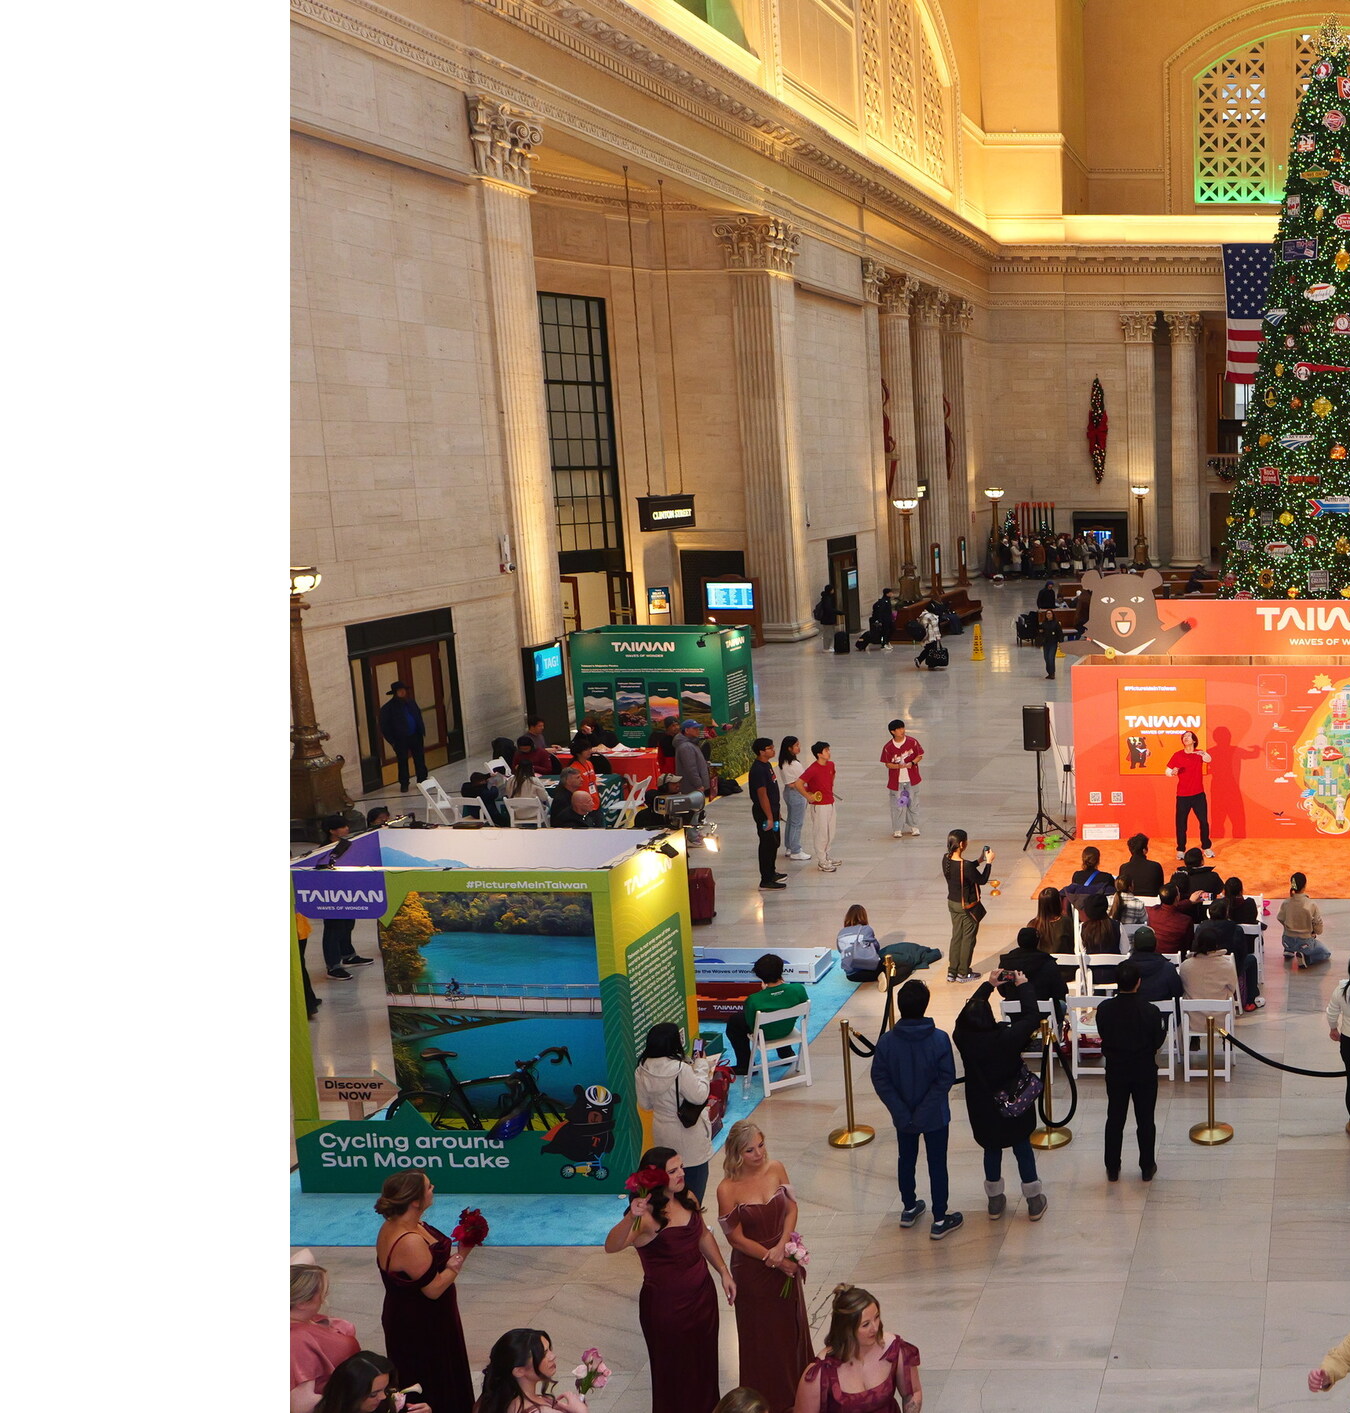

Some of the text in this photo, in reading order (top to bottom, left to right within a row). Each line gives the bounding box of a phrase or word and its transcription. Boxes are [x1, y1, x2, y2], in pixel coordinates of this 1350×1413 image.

[652, 508, 692, 520] CLINTON STREET
[611, 642, 675, 652] TAIWAN
[725, 636, 745, 648] TAIWAN
[544, 656, 559, 668] TAG!
[1125, 716, 1200, 728] TAIWAN
[466, 880, 588, 890] #PictureMeInTaiwan
[298, 890, 384, 903] TAIWAN
[324, 1080, 384, 1090] Discover
[338, 1091, 372, 1100] NOW
[319, 1133, 505, 1152] Cycling around
[321, 1152, 510, 1168] Sun Moon Lake
